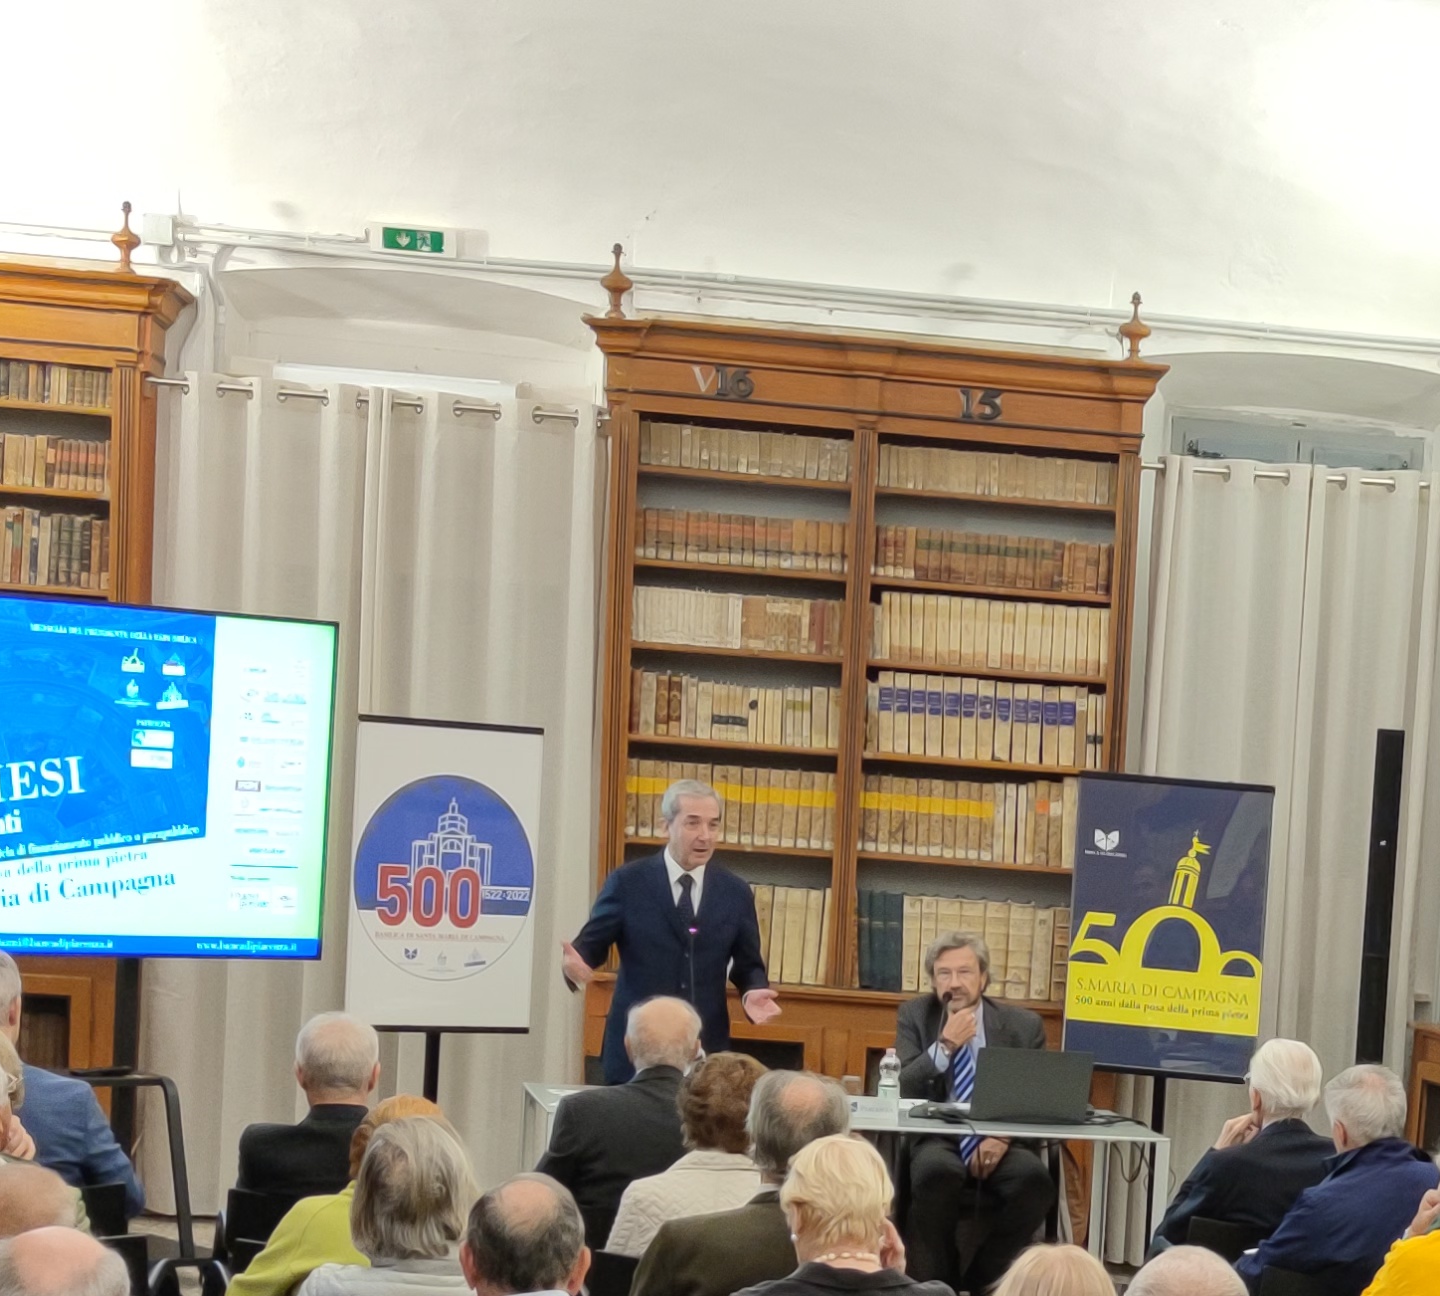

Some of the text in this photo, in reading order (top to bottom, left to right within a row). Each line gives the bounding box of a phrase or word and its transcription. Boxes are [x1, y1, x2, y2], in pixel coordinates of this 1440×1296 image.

[959, 388, 1004, 422] 15
[17, 860, 52, 876] della
[58, 856, 100, 874] prima
[106, 851, 148, 869] pietra
[29, 882, 50, 904] di
[59, 872, 176, 900] Campagna
[376, 863, 482, 929] 500
[1075, 995, 1093, 1006] 500
[1095, 999, 1116, 1008] anni
[1118, 999, 1141, 1010] dalla
[1143, 1003, 1165, 1013] posa
[1167, 1003, 1189, 1014] della
[1191, 1006, 1220, 1018] prima
[1142, 983, 1157, 997] DI
[1162, 986, 1249, 1006] CAMPAGNA
